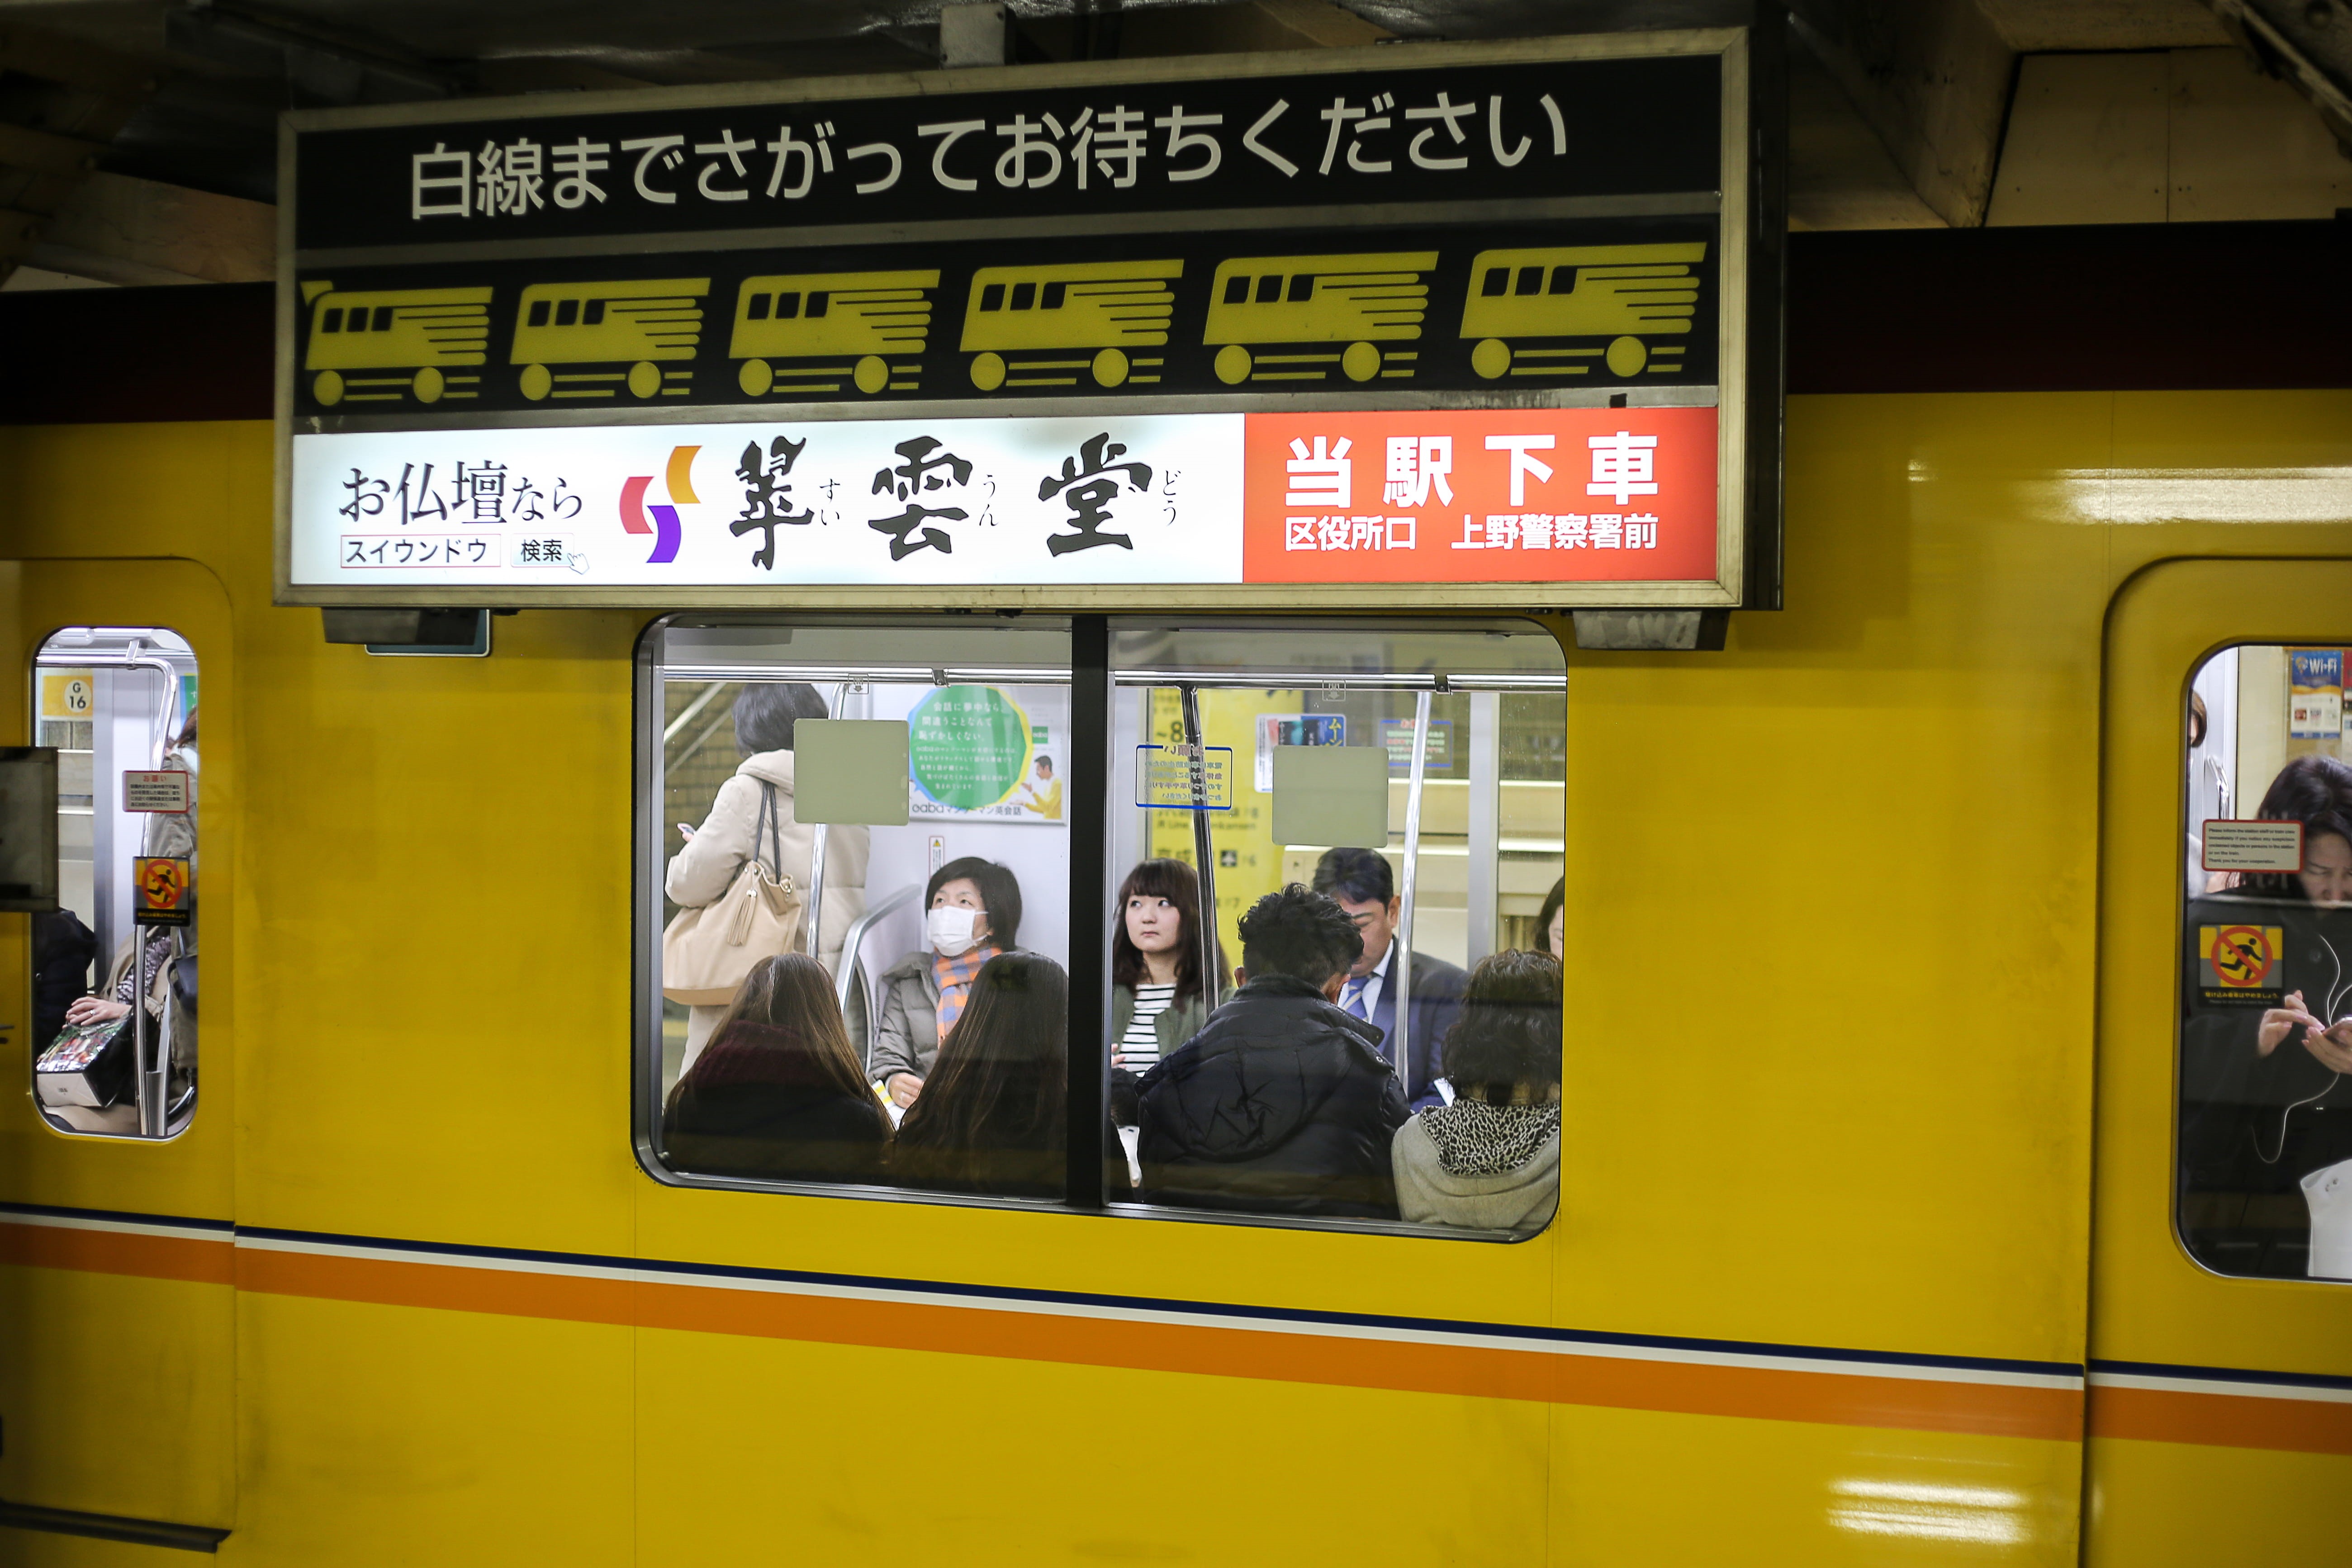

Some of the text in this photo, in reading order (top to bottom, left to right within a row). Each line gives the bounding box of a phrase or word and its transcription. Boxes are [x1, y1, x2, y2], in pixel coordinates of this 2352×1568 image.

[412, 92, 1567, 220] 白線までさがってお待ちください
[339, 460, 583, 525] お仏壇なら
[1285, 431, 1659, 508] 当駅下車
[820, 478, 840, 526] すい
[979, 474, 998, 527] うん
[1163, 469, 1181, 526] どう
[346, 539, 562, 563] スイウンドウ 検索
[1285, 513, 1659, 551] 区役所口 上野警察署前
[73, 682, 81, 693] G
[2309, 658, 2337, 675] Wi-Fi
[70, 696, 86, 709] 16
